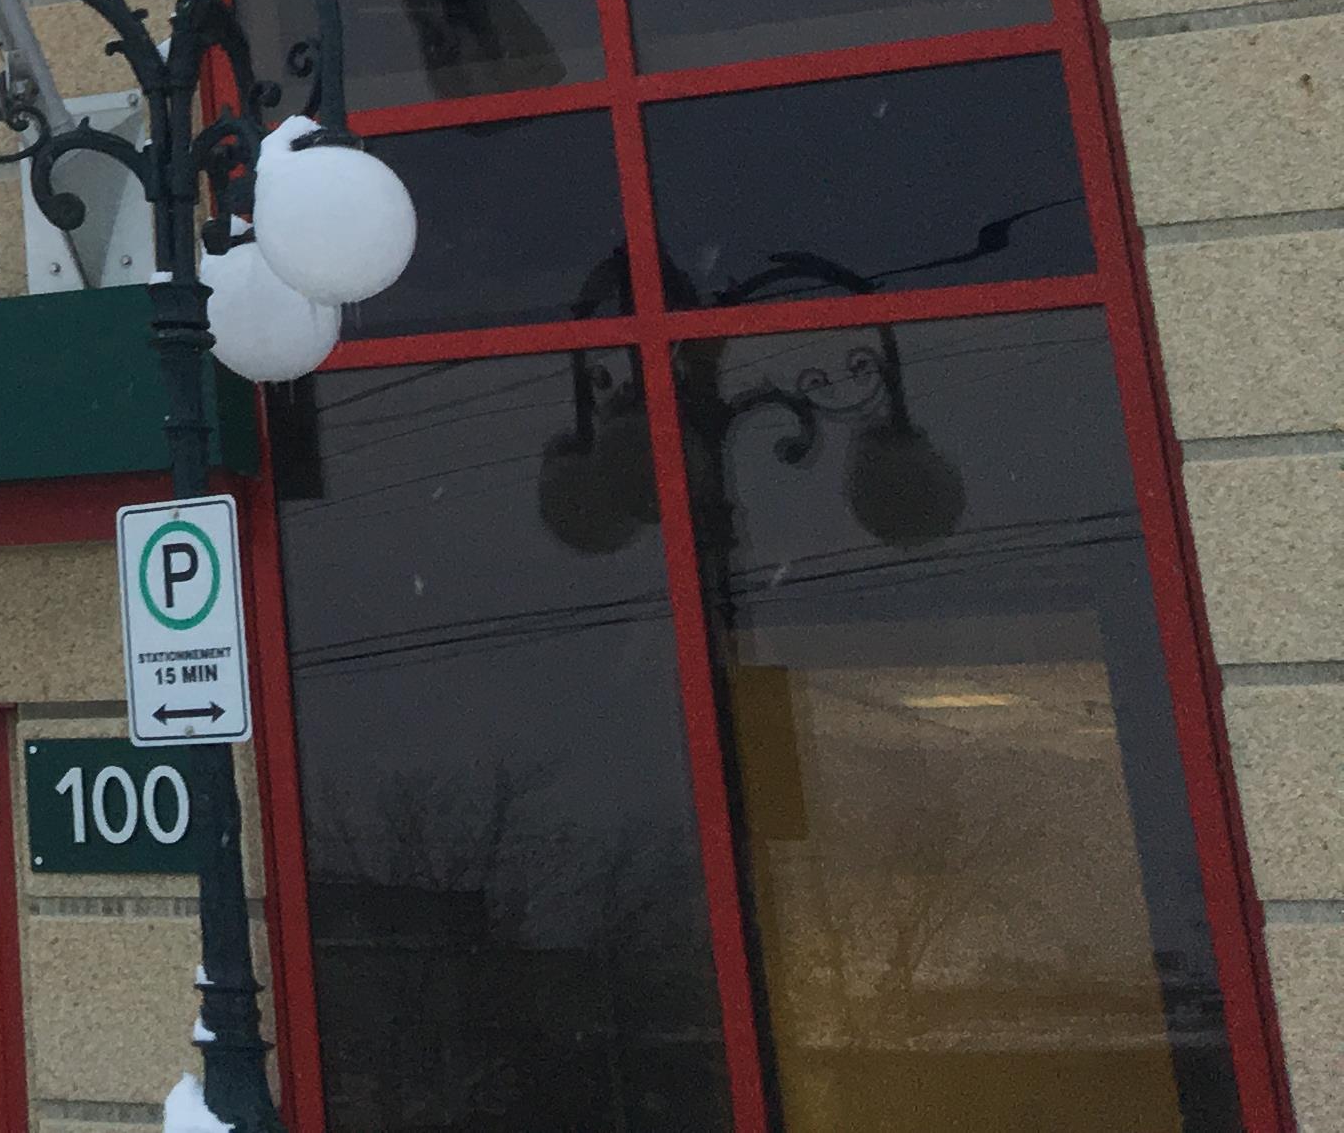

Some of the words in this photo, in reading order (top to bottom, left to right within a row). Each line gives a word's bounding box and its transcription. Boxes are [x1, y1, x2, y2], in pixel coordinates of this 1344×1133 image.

[162, 543, 199, 608] P
[137, 646, 232, 664] STATIONNEMENT
[154, 667, 177, 686] 15
[181, 663, 218, 685] MIN
[55, 764, 191, 845] 100
